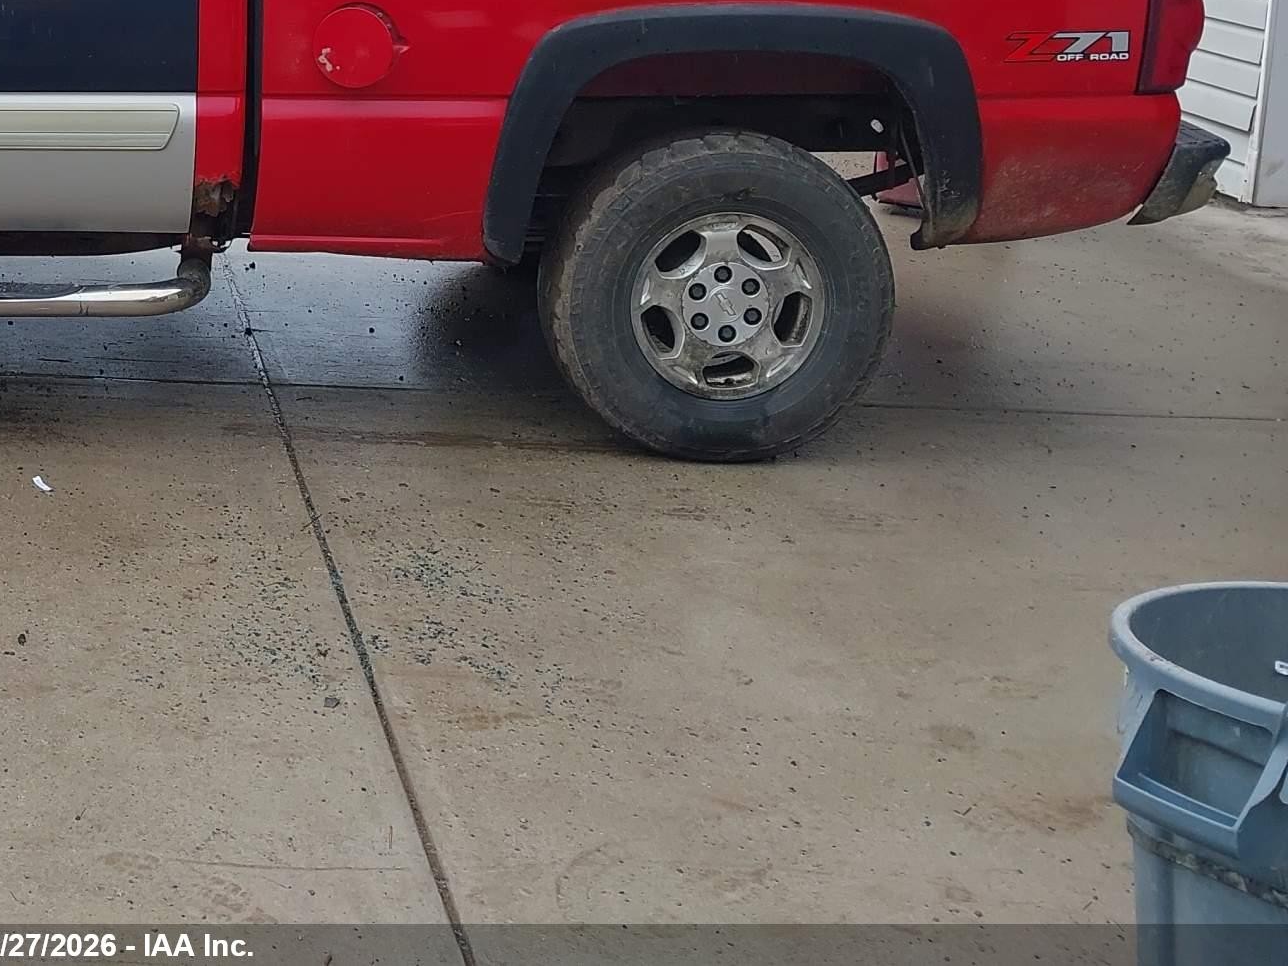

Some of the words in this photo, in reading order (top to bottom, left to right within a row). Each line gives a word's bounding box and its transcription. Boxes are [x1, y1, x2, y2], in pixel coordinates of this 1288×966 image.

[1003, 30, 1131, 63] Z71
[1056, 53, 1084, 62] OFF
[1089, 53, 1129, 61] ROAD
